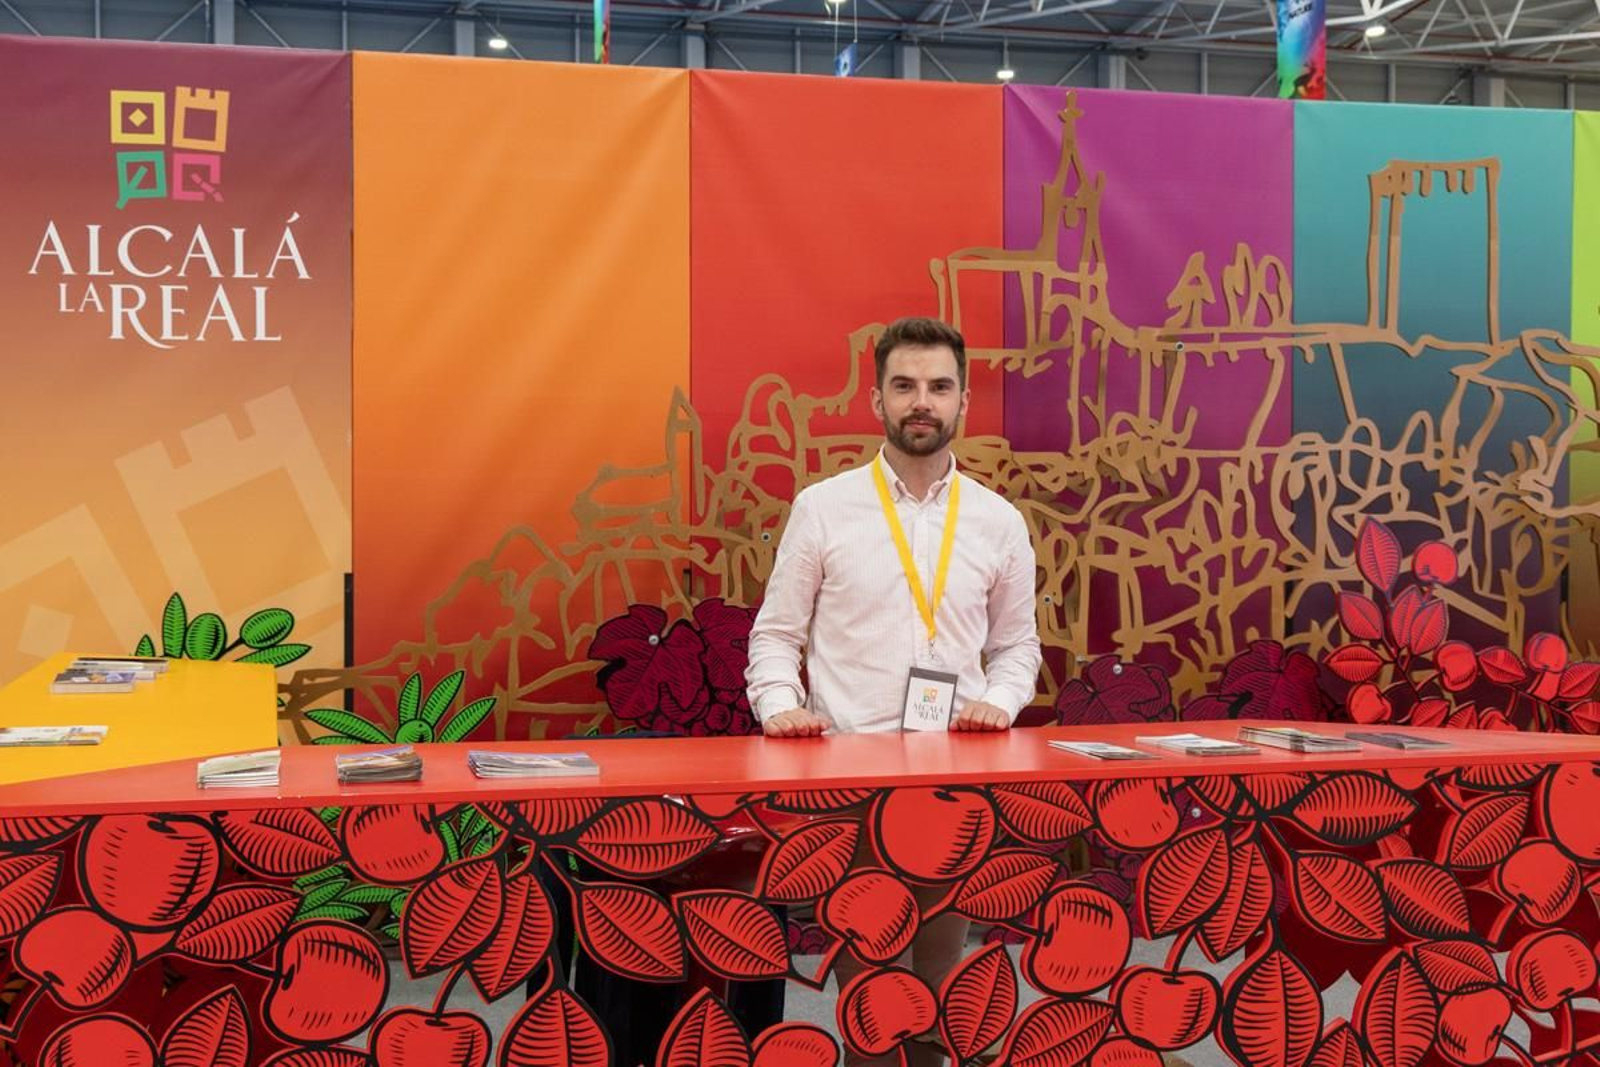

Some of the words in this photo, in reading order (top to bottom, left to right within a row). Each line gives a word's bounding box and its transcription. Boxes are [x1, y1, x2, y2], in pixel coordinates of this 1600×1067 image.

[28, 211, 312, 279] ALCALÁ
[59, 282, 105, 312] LA
[109, 283, 282, 349] REAL
